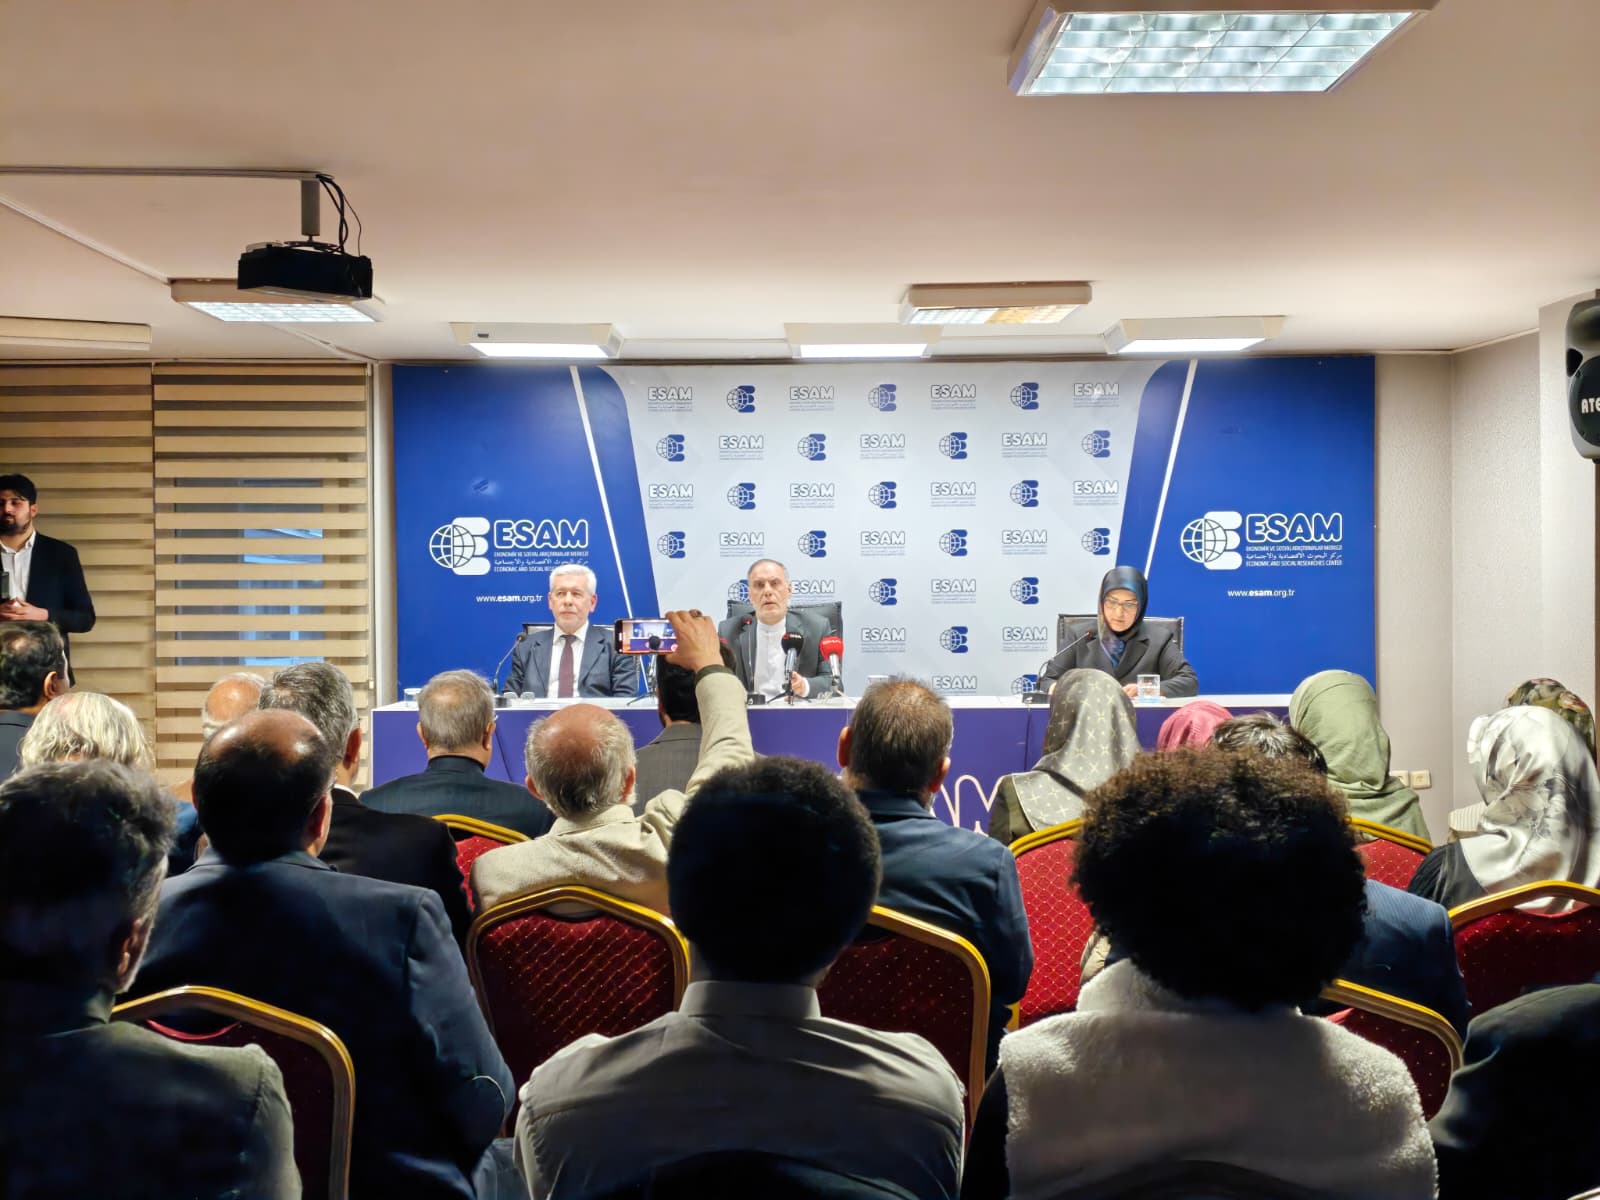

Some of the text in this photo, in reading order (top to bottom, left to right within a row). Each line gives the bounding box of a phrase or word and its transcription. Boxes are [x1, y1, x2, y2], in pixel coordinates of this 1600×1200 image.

[648, 386, 693, 400] ESAM
[789, 386, 834, 400] ESAM
[931, 384, 976, 399] ESAM
[1074, 382, 1119, 396] ESAM
[719, 435, 764, 449] ESAM
[860, 434, 905, 448] ESAM
[1002, 432, 1047, 447] ESAM
[648, 484, 693, 498] ESAM
[790, 483, 835, 497] ESAM
[931, 482, 976, 497] ESAM
[1073, 480, 1119, 495] ESAM
[493, 519, 589, 549] ESAM
[1246, 512, 1343, 543] ESAM
[719, 532, 764, 546] ESAM
[861, 531, 905, 545] ESAM
[1002, 529, 1047, 544] ESAM
[791, 580, 835, 594] ESAM
[931, 579, 976, 593] ESAM
[476, 594, 544, 604] www.esam.org.tr
[1227, 588, 1295, 599] www.esam.org.tr
[861, 628, 906, 642] ESAM
[1002, 626, 1048, 641] ESAM
[932, 675, 977, 690] ESAM
